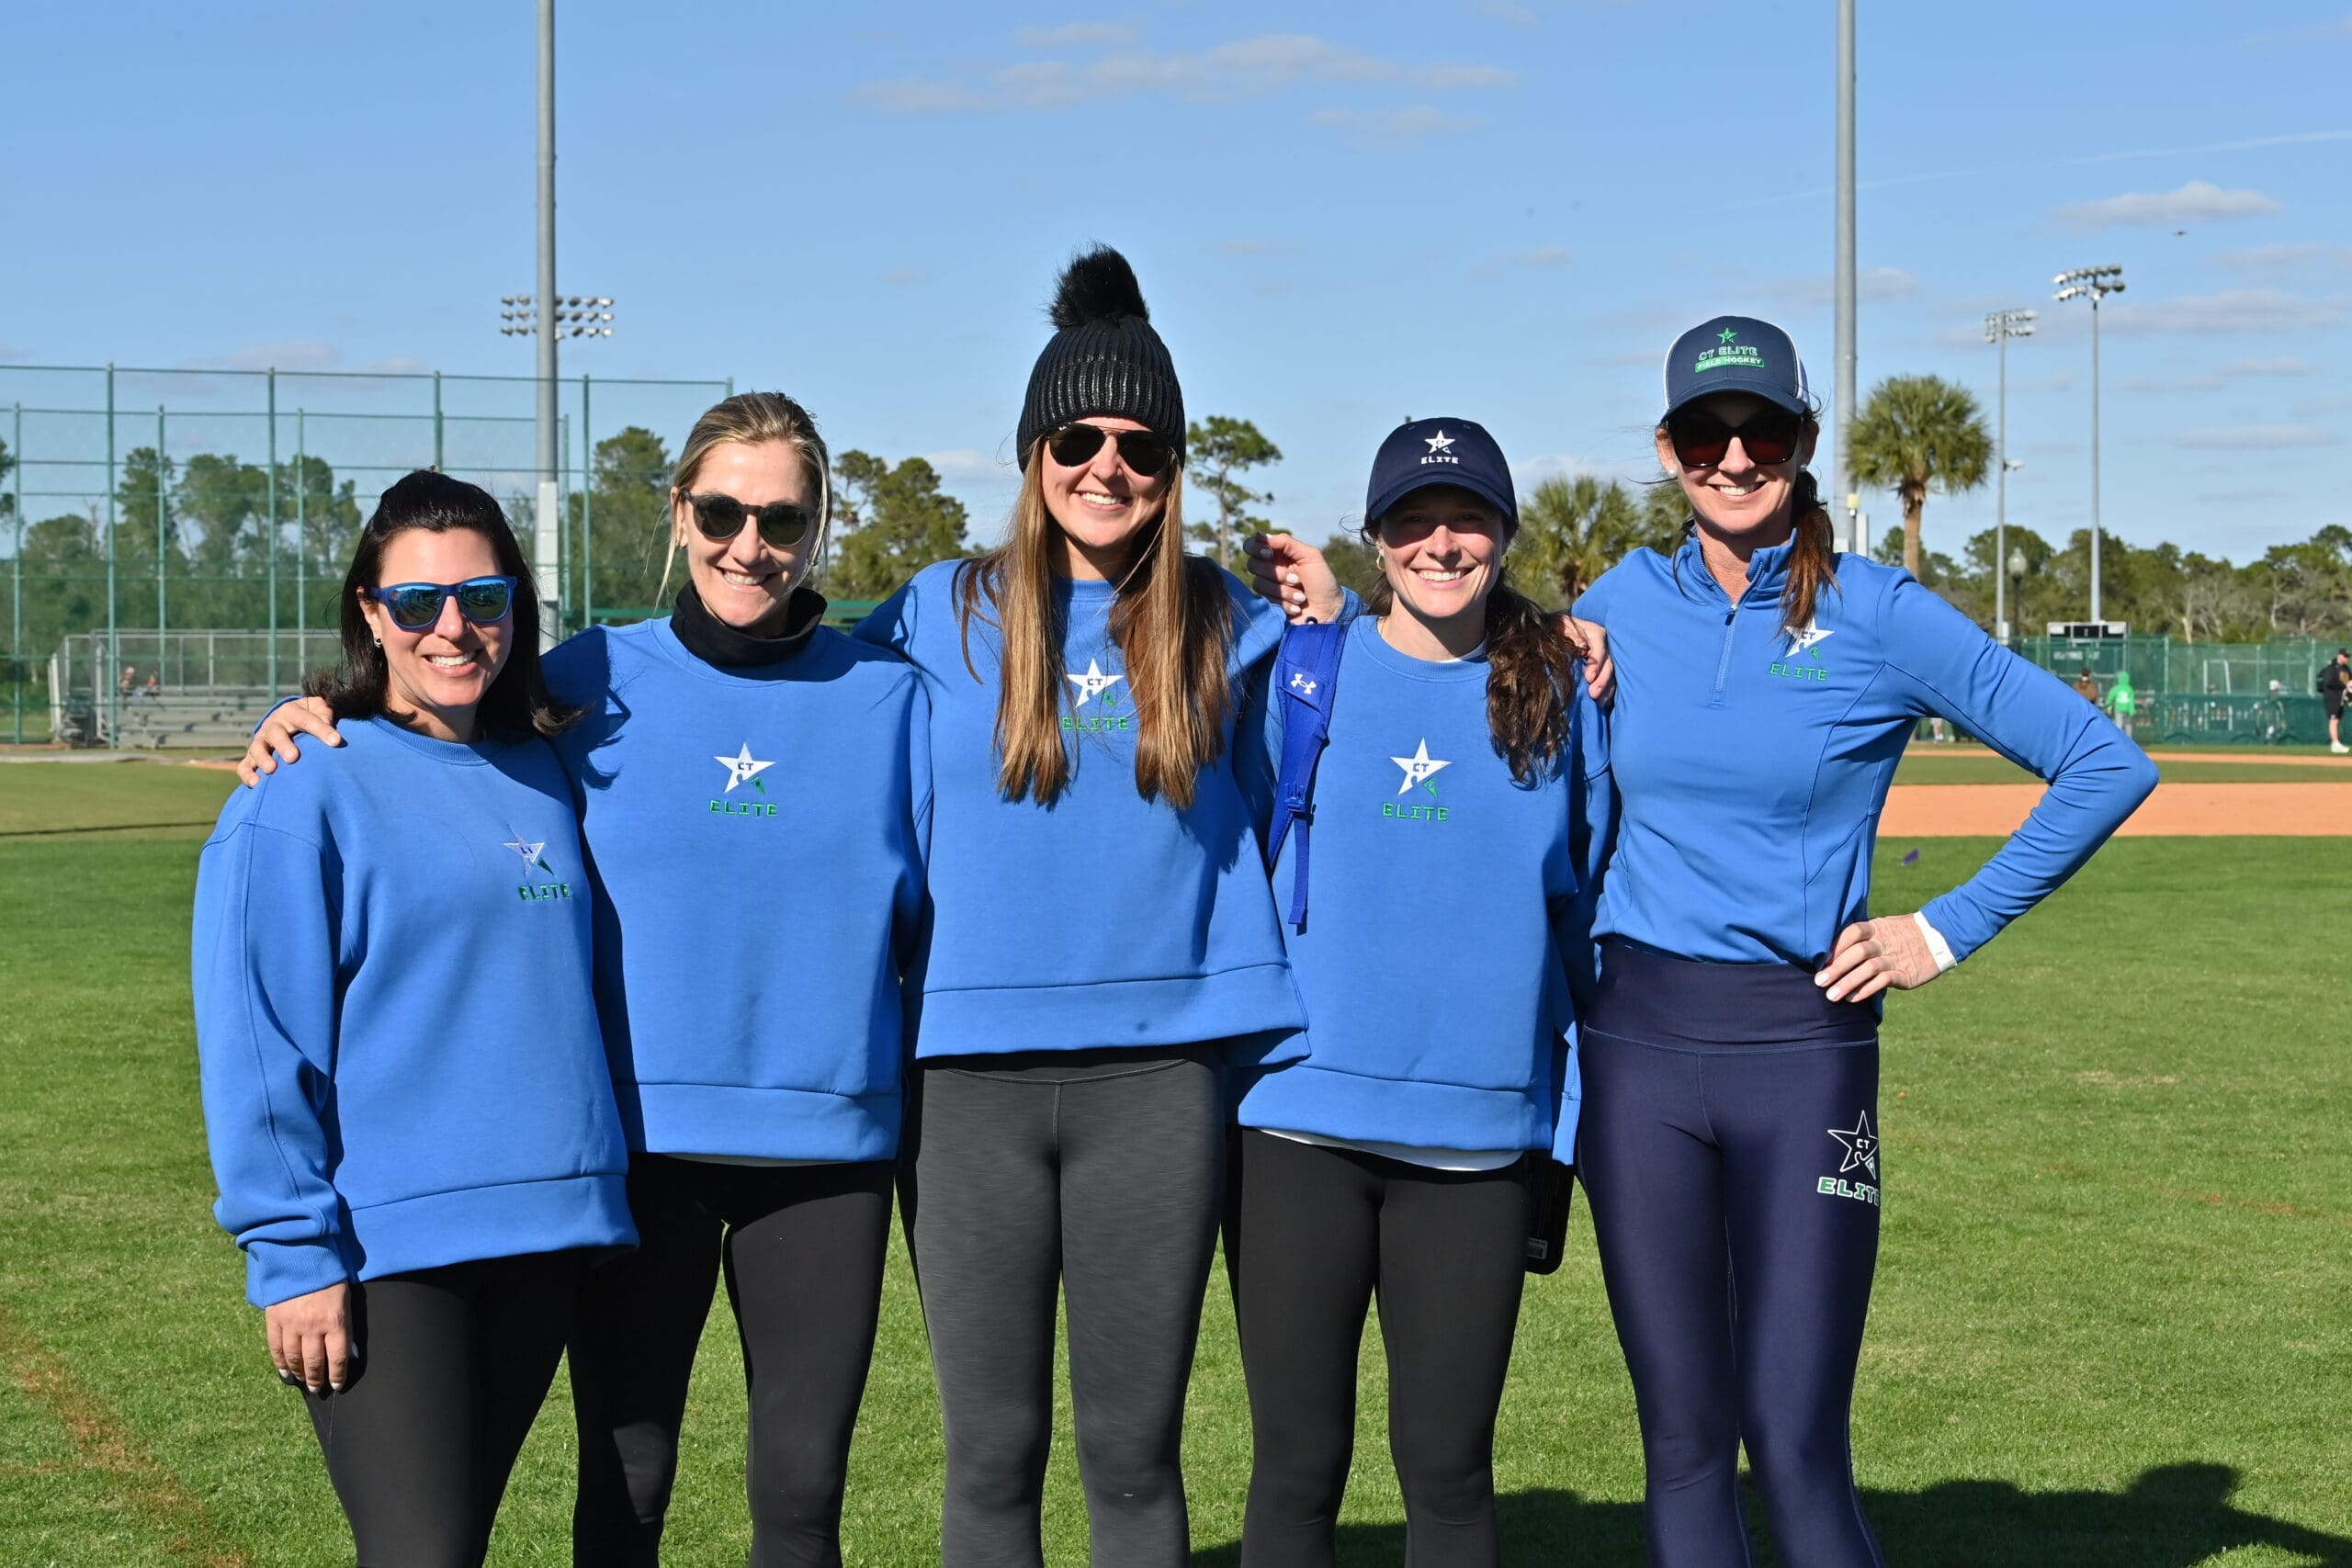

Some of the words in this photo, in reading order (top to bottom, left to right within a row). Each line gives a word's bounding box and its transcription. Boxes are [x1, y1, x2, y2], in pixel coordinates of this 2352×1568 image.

[1699, 349, 1714, 361] CT
[1718, 346, 1758, 356] ELITE
[1724, 356, 1761, 365] HOCKEY
[1420, 456, 1459, 465] ELITE
[1801, 632, 1815, 640] CT
[1770, 662, 1828, 681] ELITE
[1062, 716, 1129, 731] ELITE
[738, 762, 753, 771] CT
[1413, 762, 1430, 773] CT
[710, 800, 778, 817] ELITE
[1383, 802, 1449, 821] ELITE
[518, 883, 571, 901] ELITE
[1856, 1138, 1870, 1149] CT
